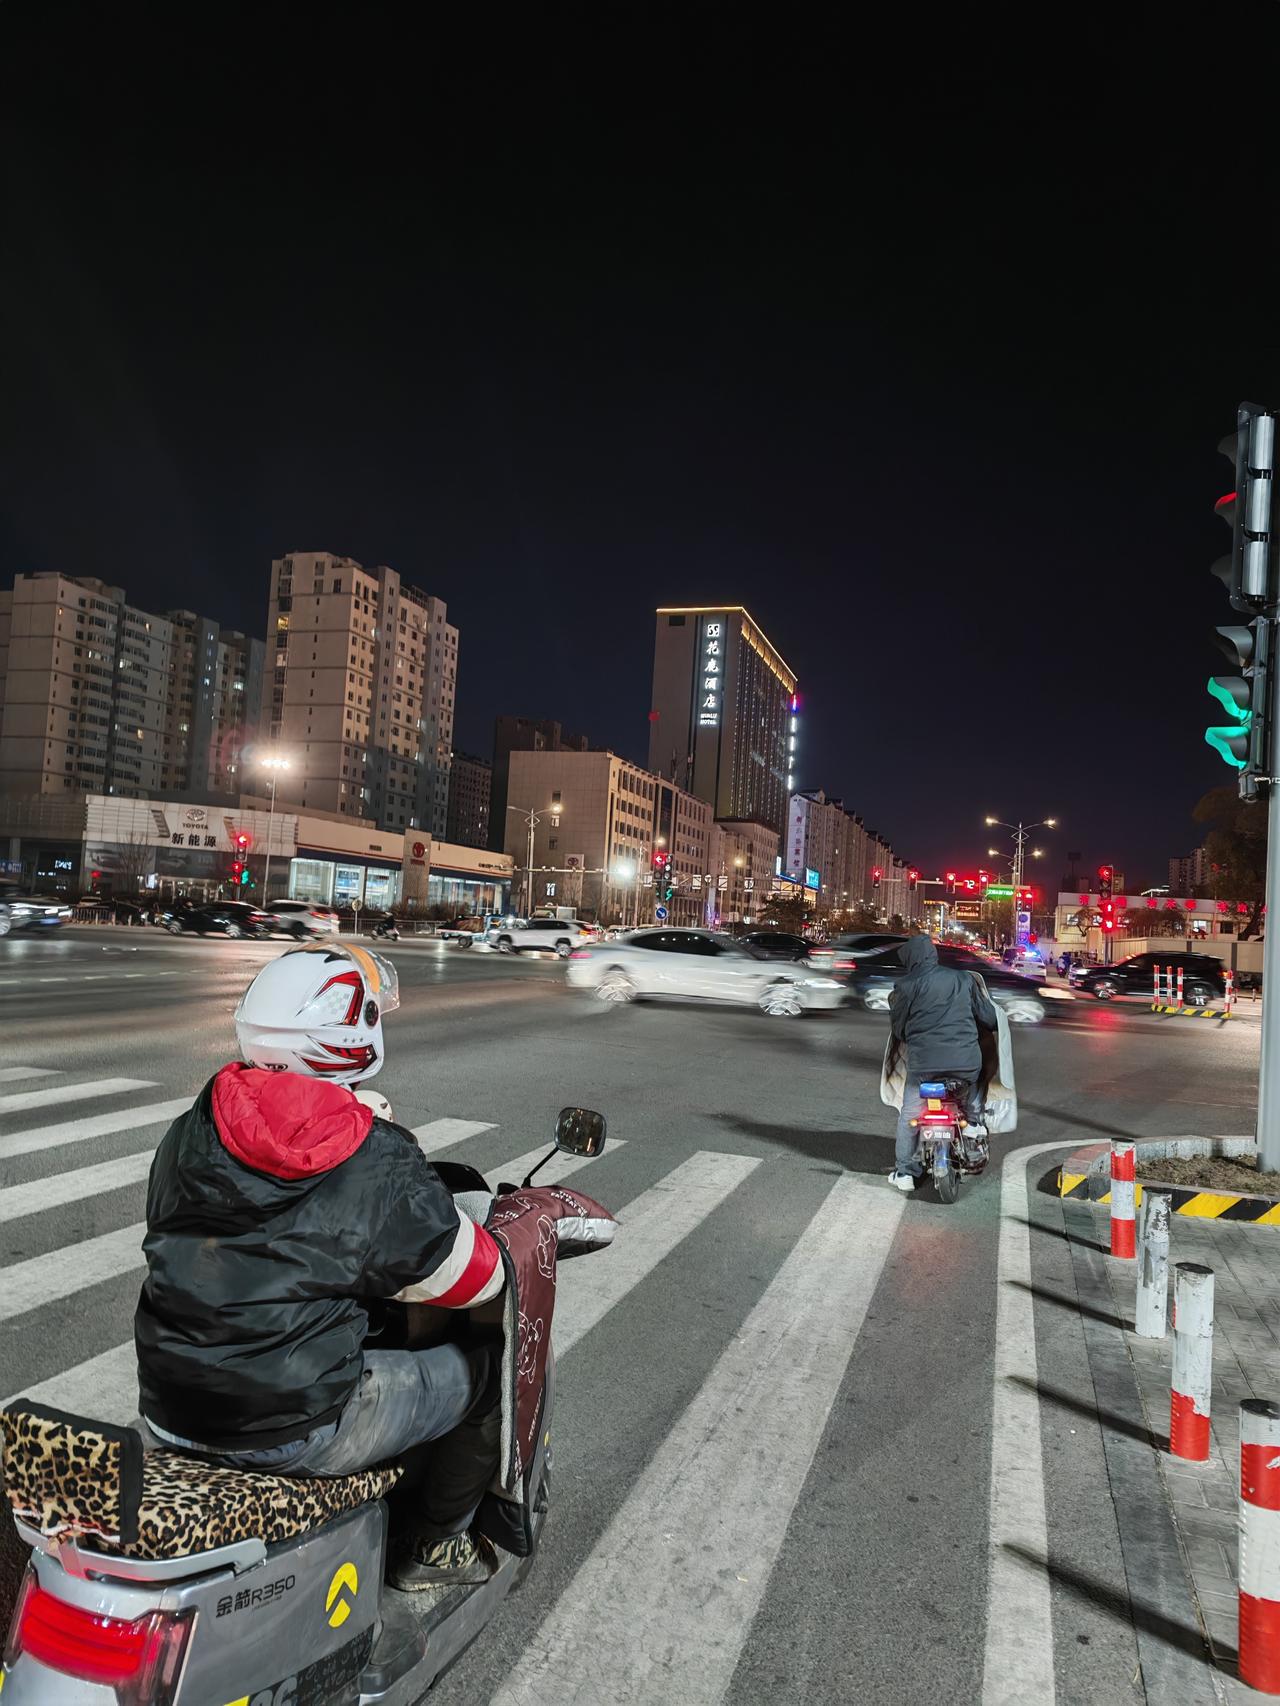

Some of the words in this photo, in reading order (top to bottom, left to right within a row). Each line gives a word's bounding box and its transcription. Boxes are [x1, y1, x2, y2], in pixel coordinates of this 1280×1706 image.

[703, 640, 720, 708] 花鹿酒店
[171, 832, 217, 847] 新能源
